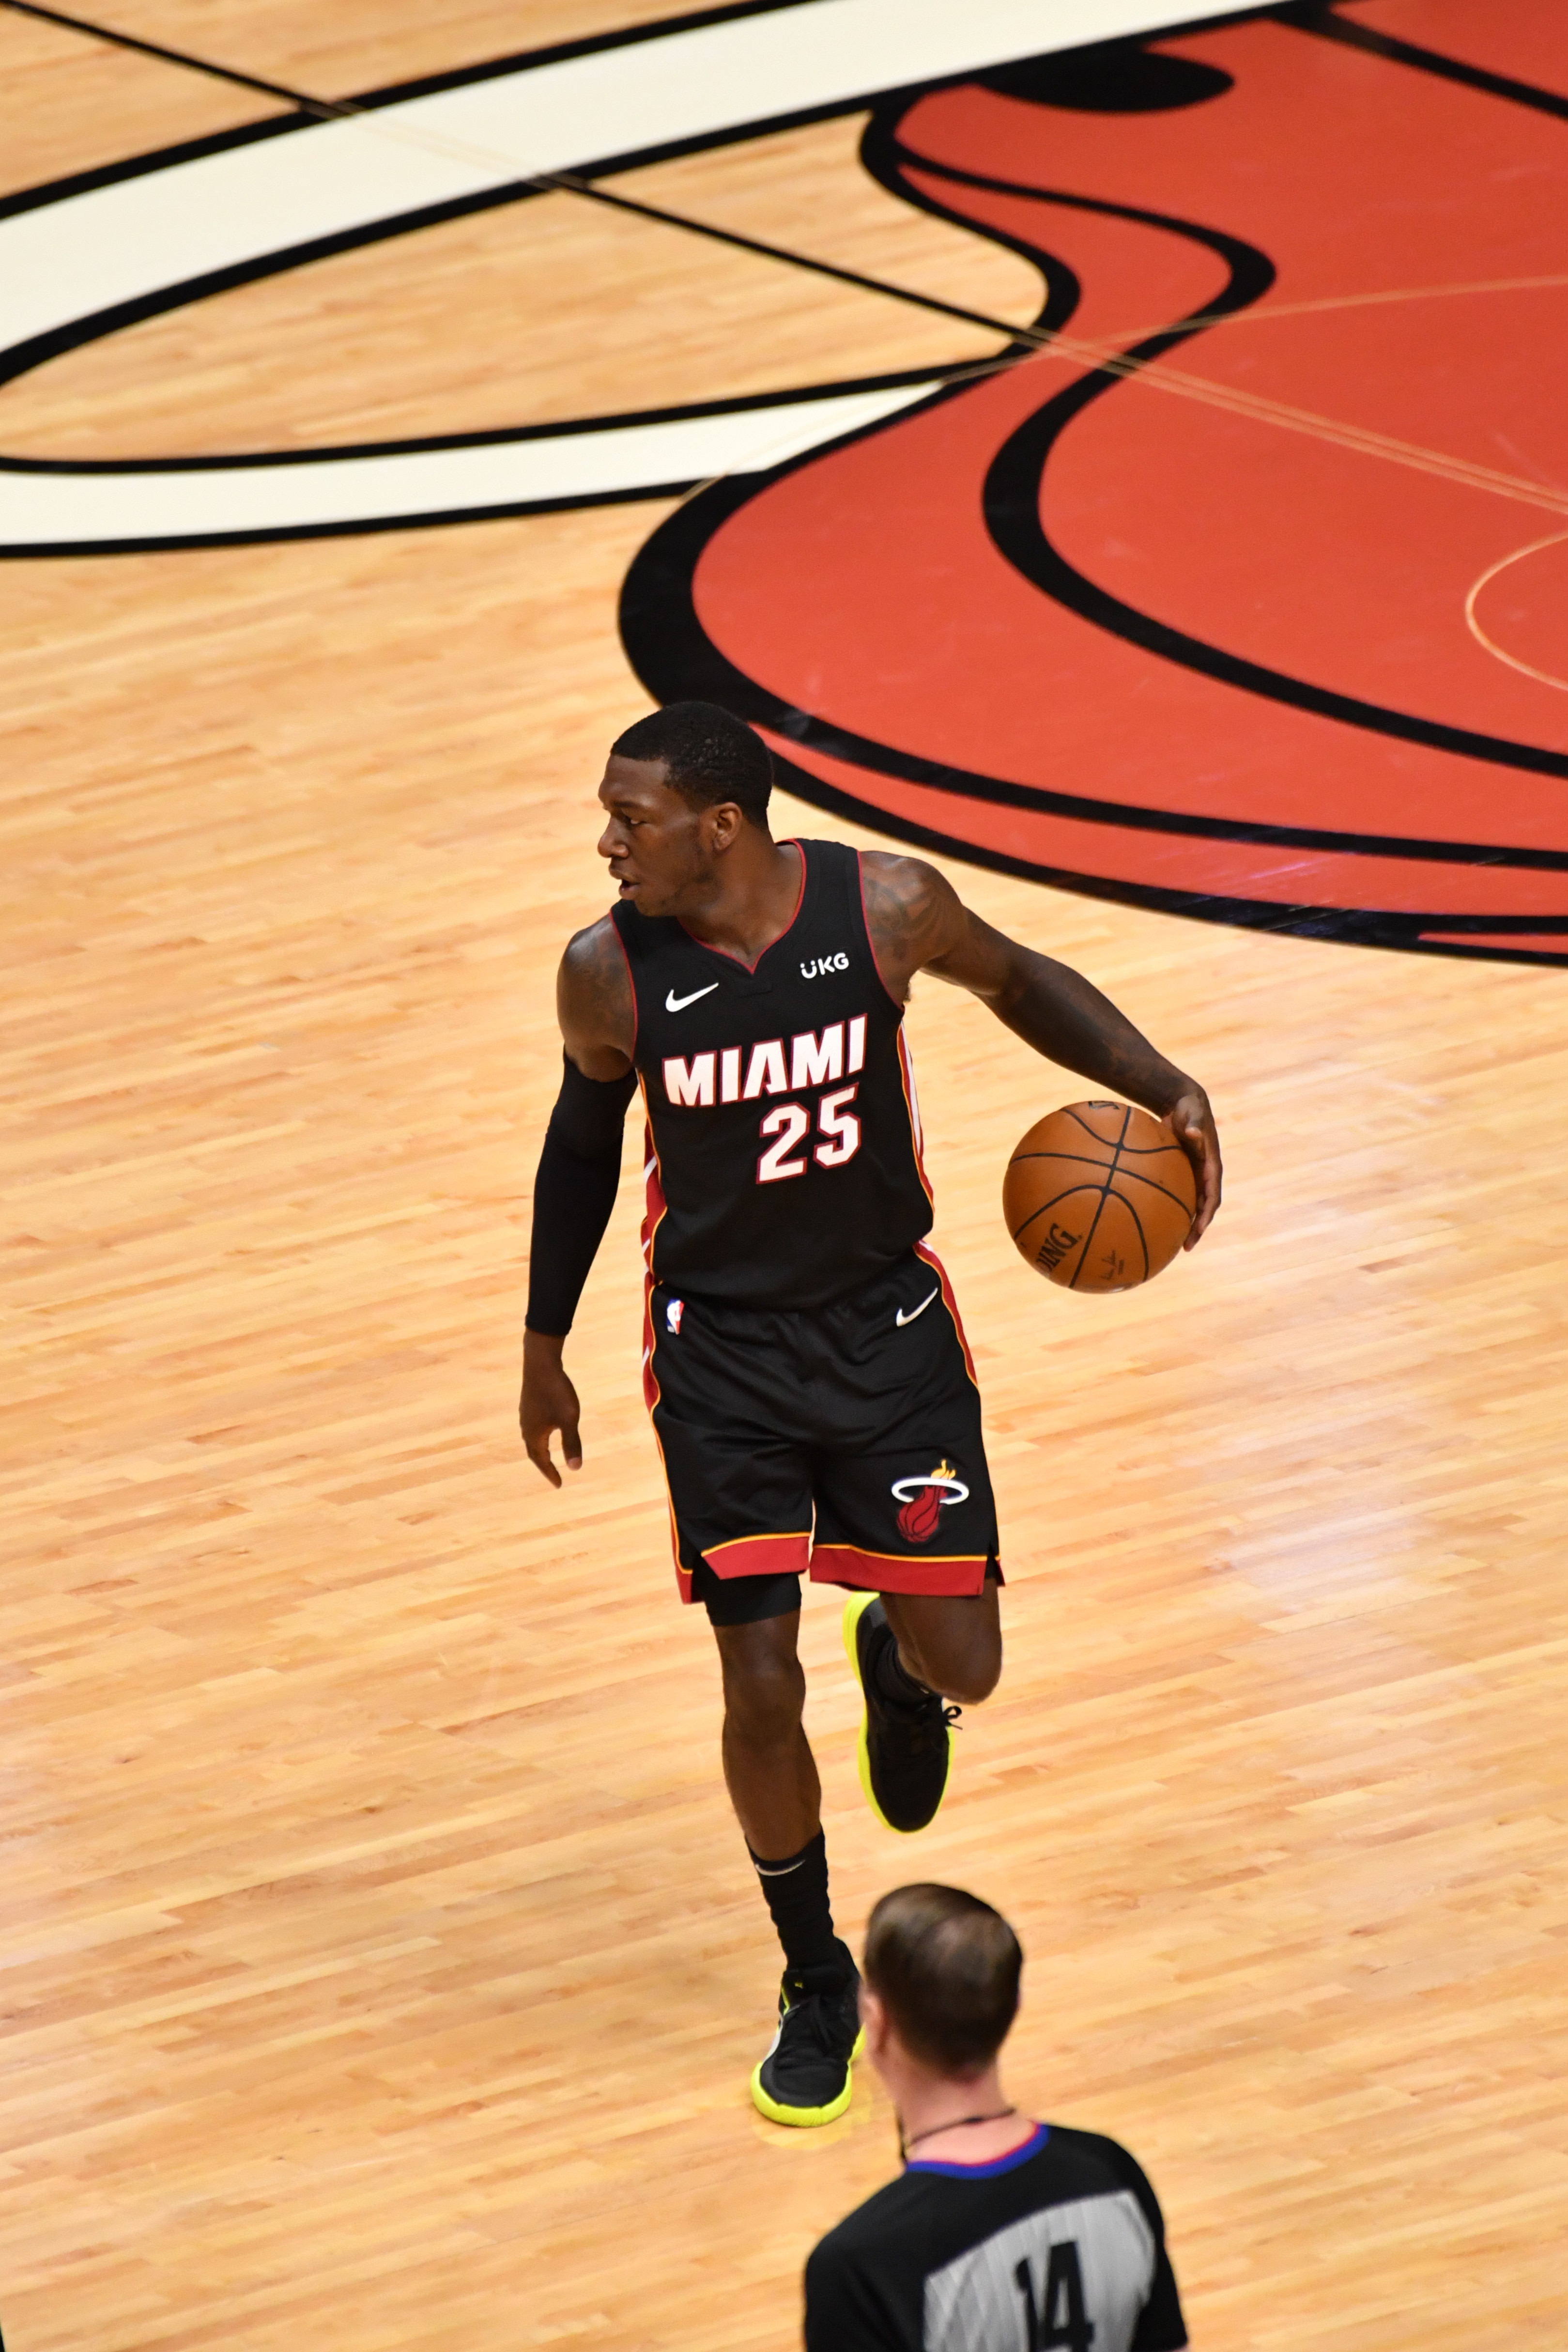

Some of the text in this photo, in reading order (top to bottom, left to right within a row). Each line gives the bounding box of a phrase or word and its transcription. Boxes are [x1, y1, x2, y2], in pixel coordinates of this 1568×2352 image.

[662, 1013, 867, 1108] MIAMI
[756, 1082, 861, 1184] 25
[1015, 2241, 1095, 2352] 14
